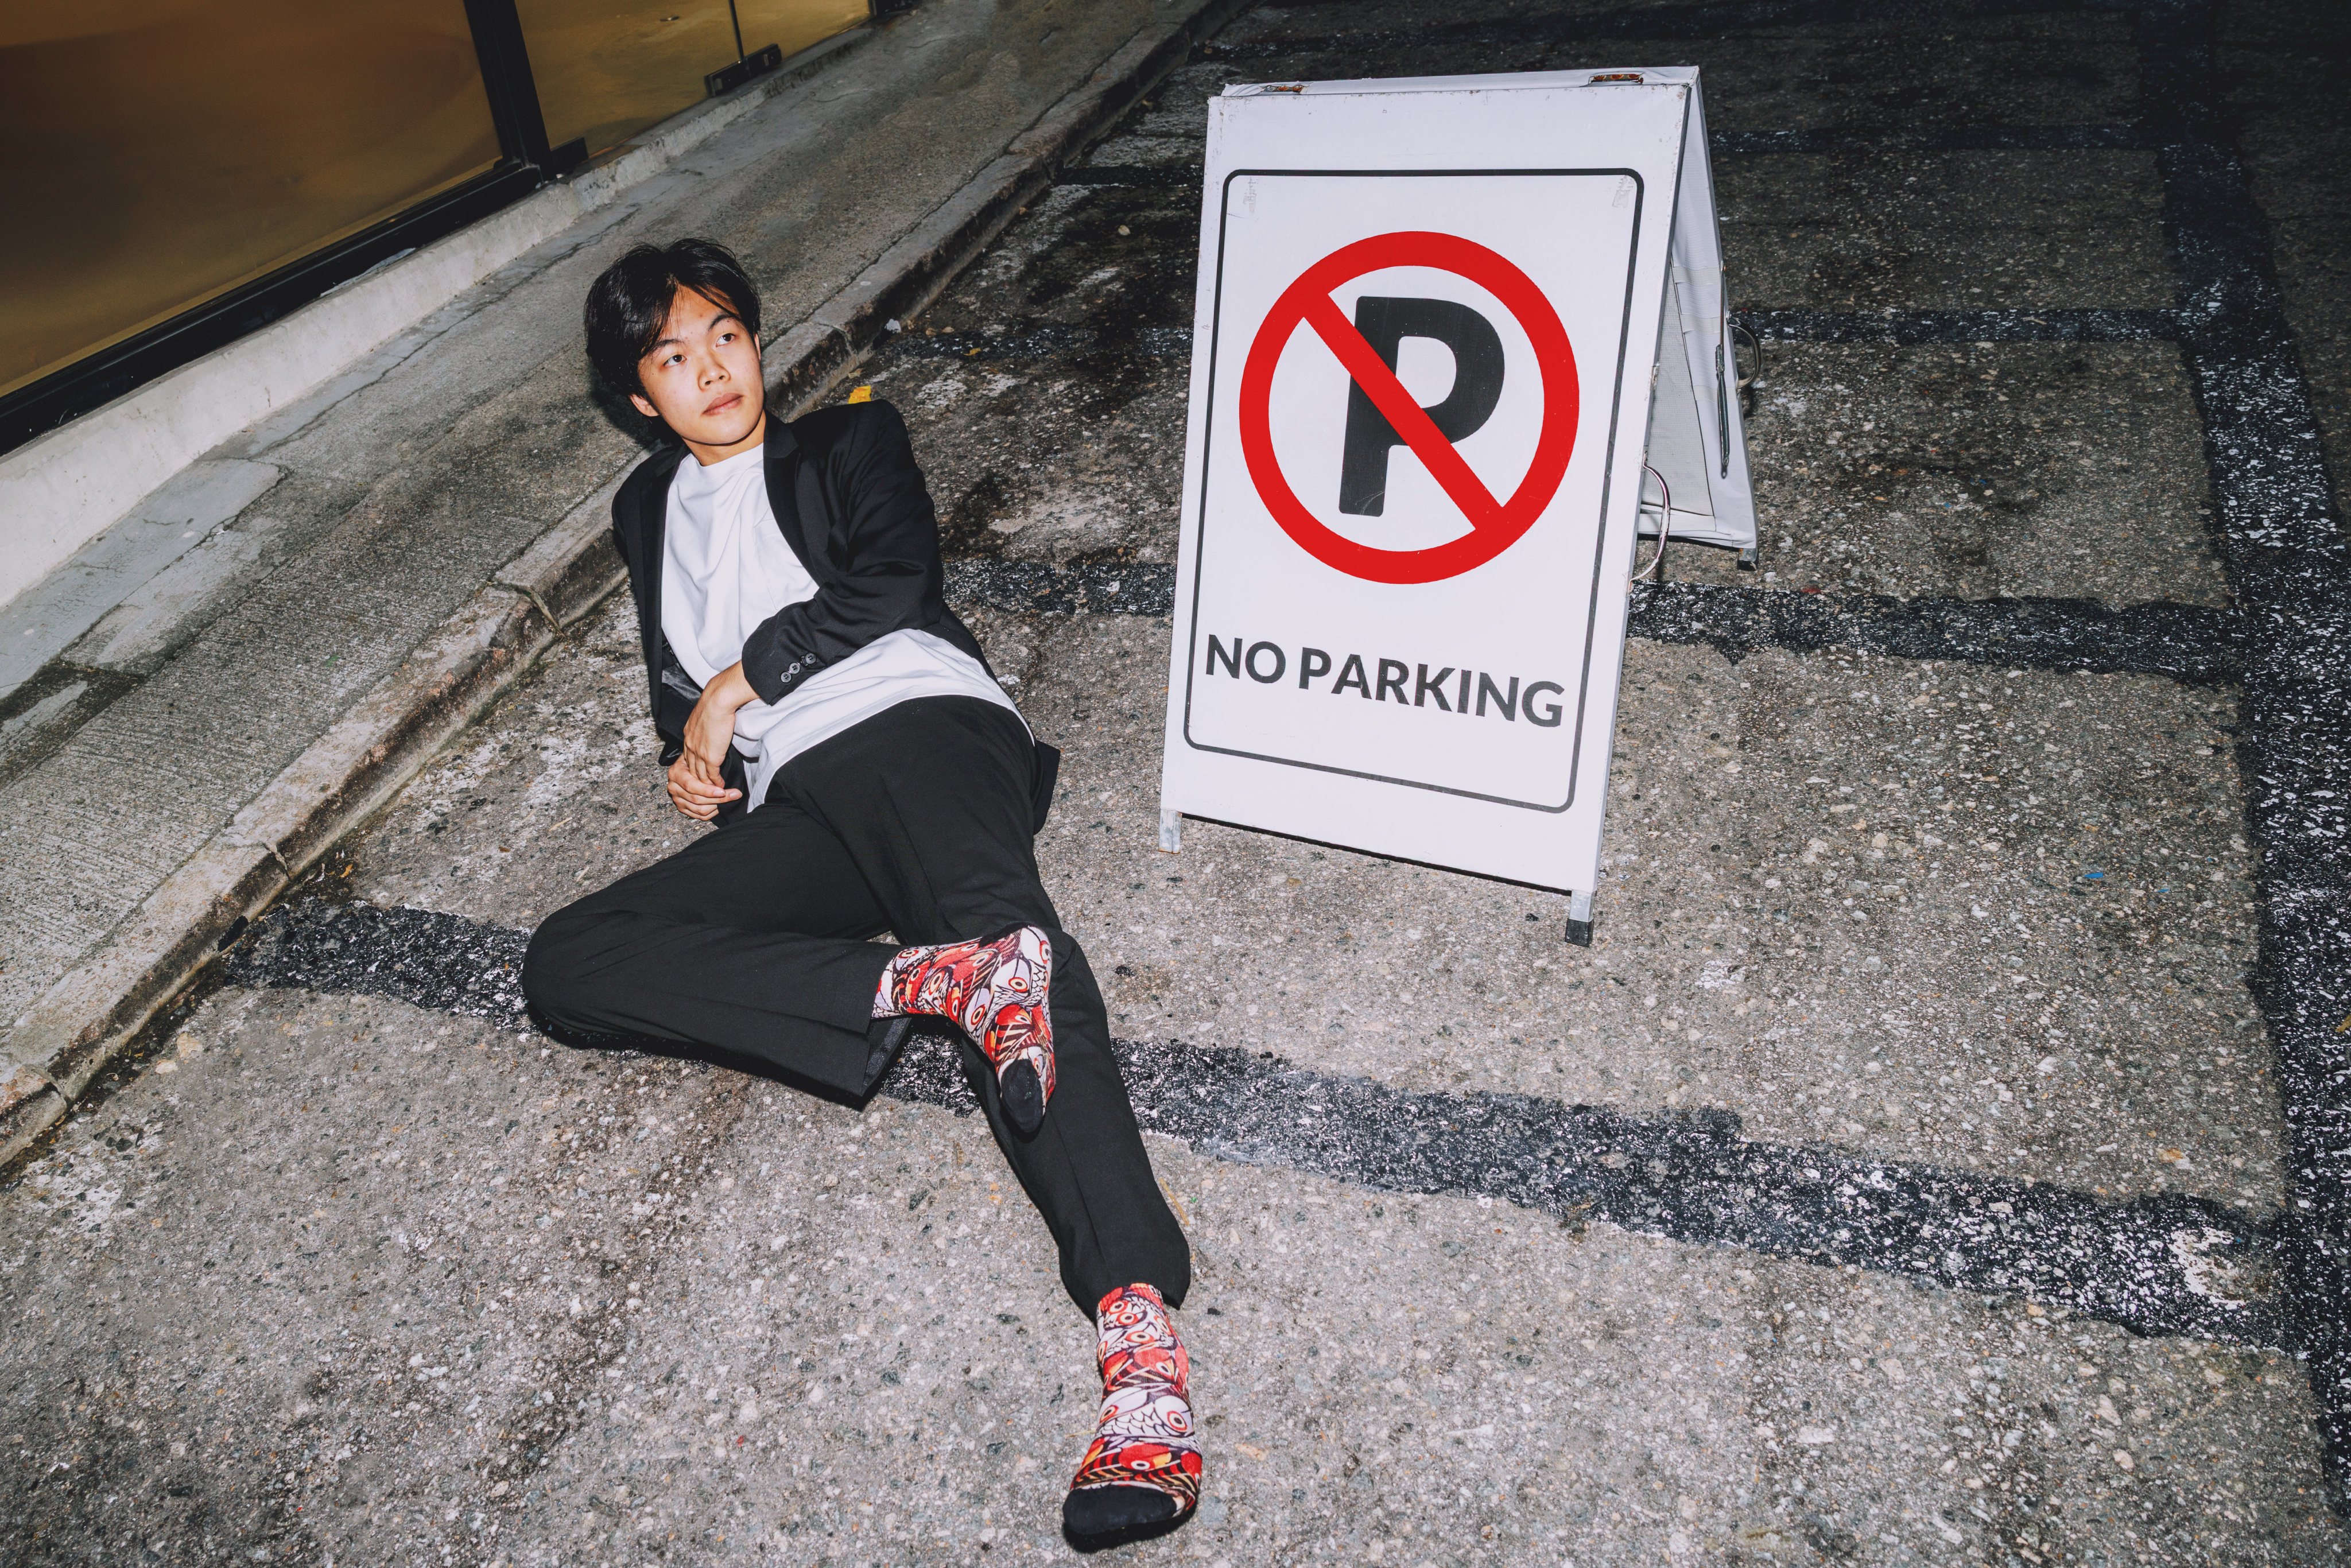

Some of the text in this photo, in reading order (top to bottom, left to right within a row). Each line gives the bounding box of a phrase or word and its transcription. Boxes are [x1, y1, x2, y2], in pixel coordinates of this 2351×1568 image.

[1339, 296, 1505, 517] P
[1205, 634, 1565, 728] NO PARKING
